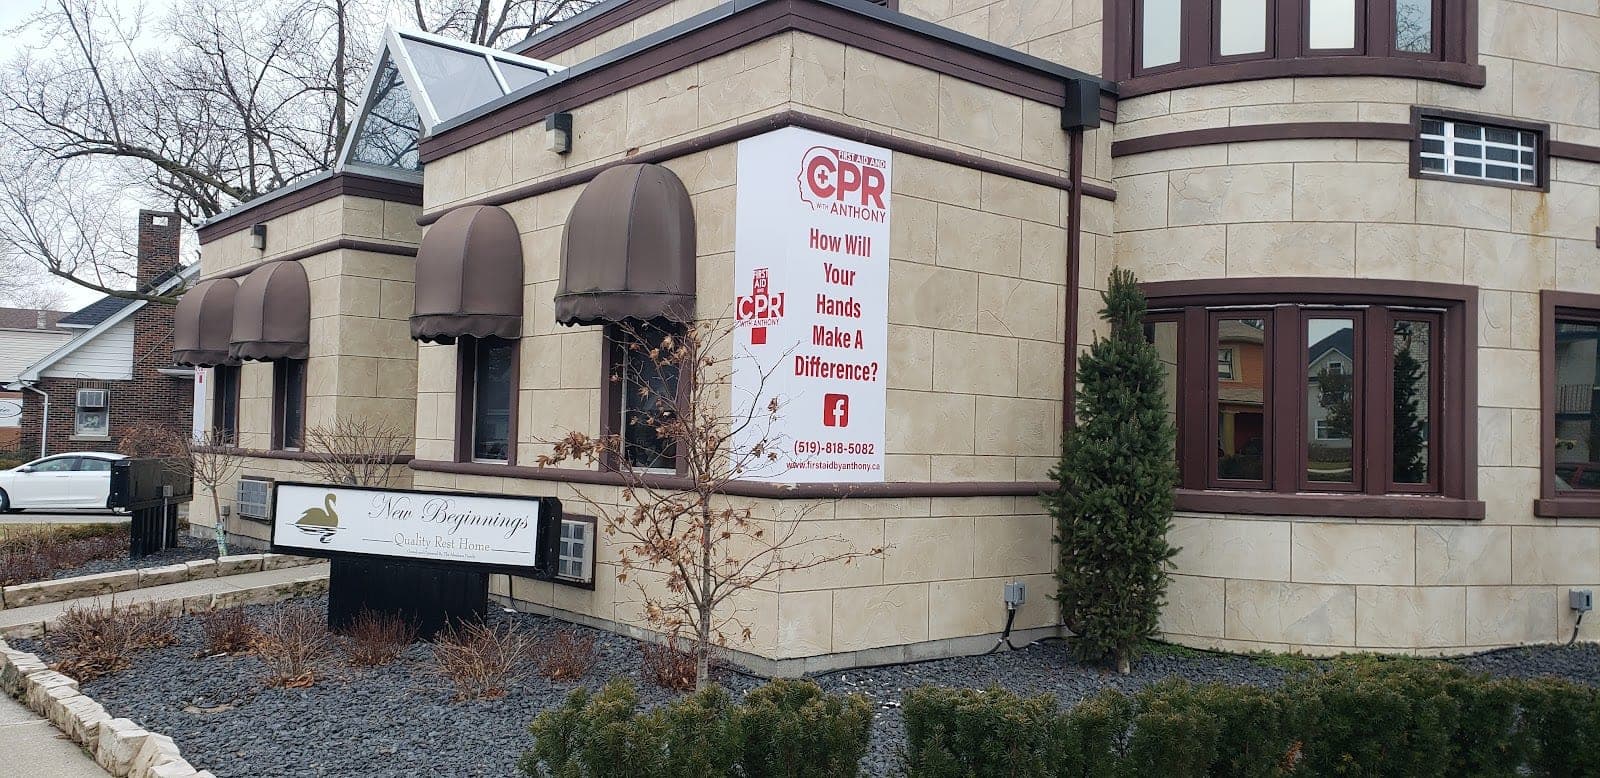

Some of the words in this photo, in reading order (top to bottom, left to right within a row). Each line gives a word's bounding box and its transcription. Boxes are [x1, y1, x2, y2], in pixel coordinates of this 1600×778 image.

[856, 155, 869, 165] AID
[807, 156, 886, 209] CPR
[830, 202, 886, 223] ANTHONY
[809, 228, 841, 253] How
[845, 234, 871, 257] Will
[754, 279, 767, 288] AID
[824, 262, 856, 286] Your
[738, 294, 783, 320] CPR
[817, 294, 861, 318] Hands
[754, 319, 780, 327] ANTHONY
[813, 325, 851, 349] Make
[855, 330, 863, 349] A
[795, 356, 878, 381] Difference?
[794, 440, 875, 456] (519)-818-5082
[786, 461, 881, 472] www.firstaidbyanthony.ca
[368, 493, 413, 521] New
[421, 497, 529, 539] Beginnings
[394, 532, 432, 548] Quality
[435, 536, 454, 548] Rest
[459, 538, 490, 551] Home
